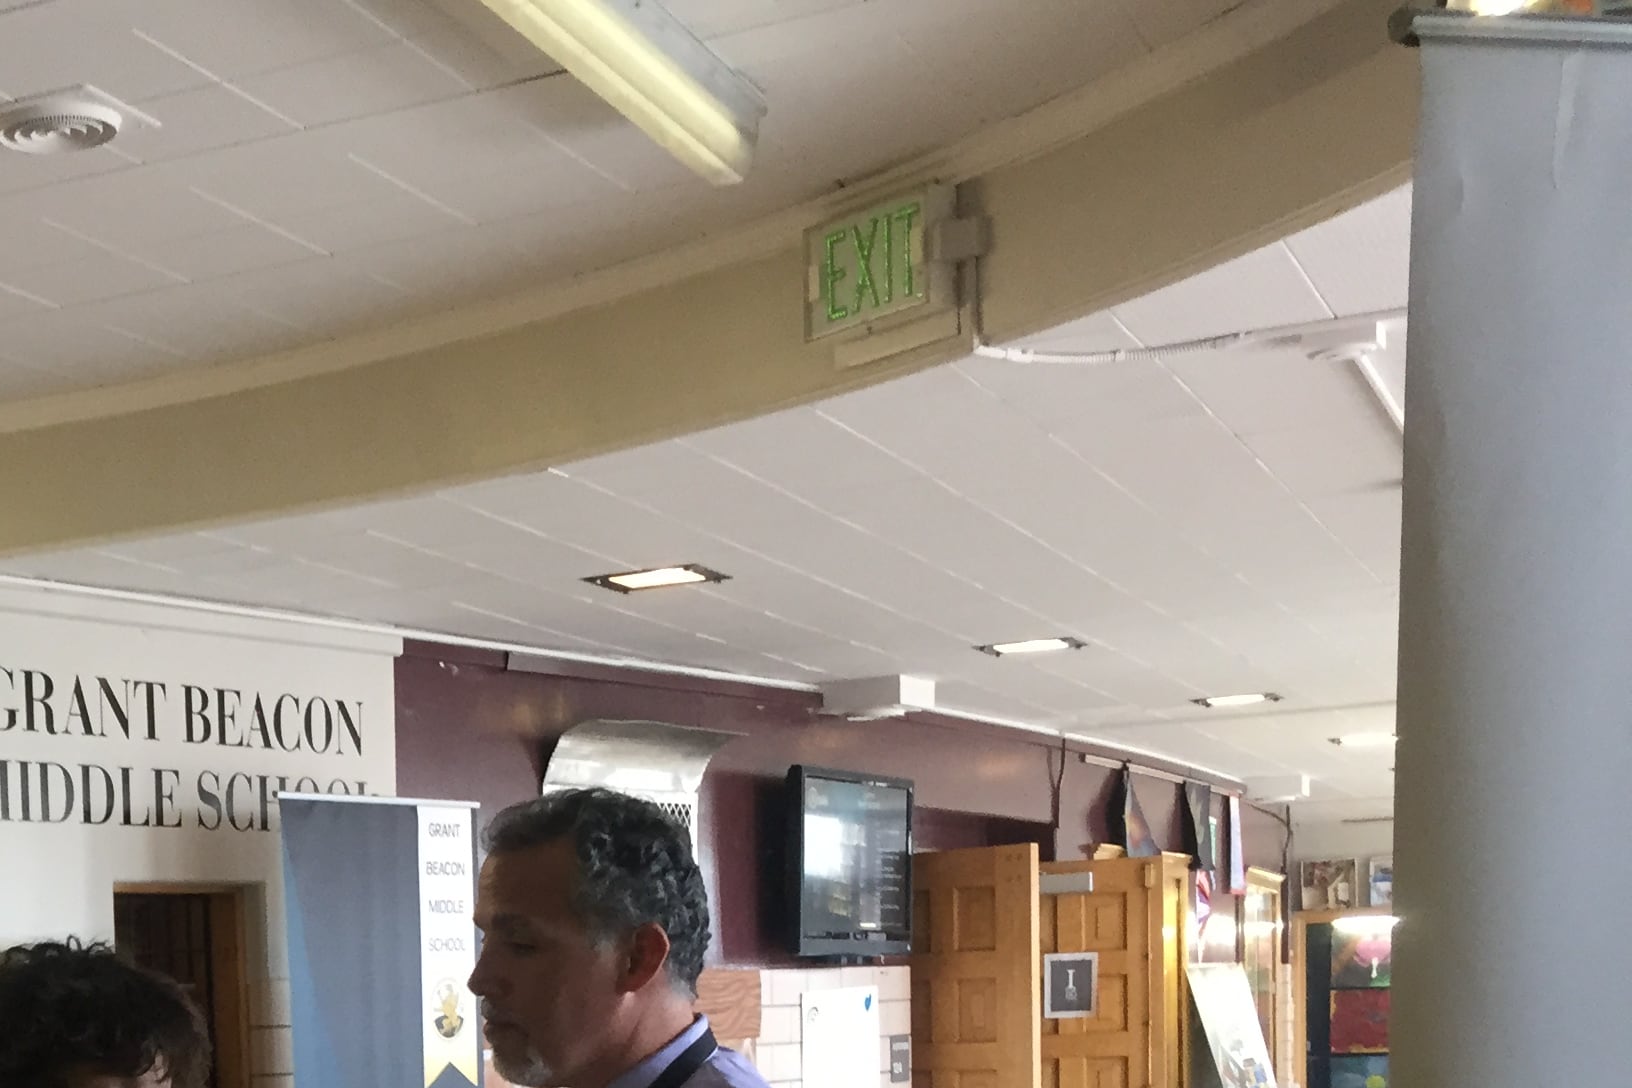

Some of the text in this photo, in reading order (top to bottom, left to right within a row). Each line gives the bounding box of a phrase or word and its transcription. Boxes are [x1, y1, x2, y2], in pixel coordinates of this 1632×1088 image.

[824, 202, 920, 321] EXIT
[181, 684, 363, 757] BEACON
[428, 822, 460, 838] GRANT
[426, 861, 465, 876] BEACON
[429, 899, 464, 914] MIDDLE
[428, 937, 466, 952] SCHOOL
